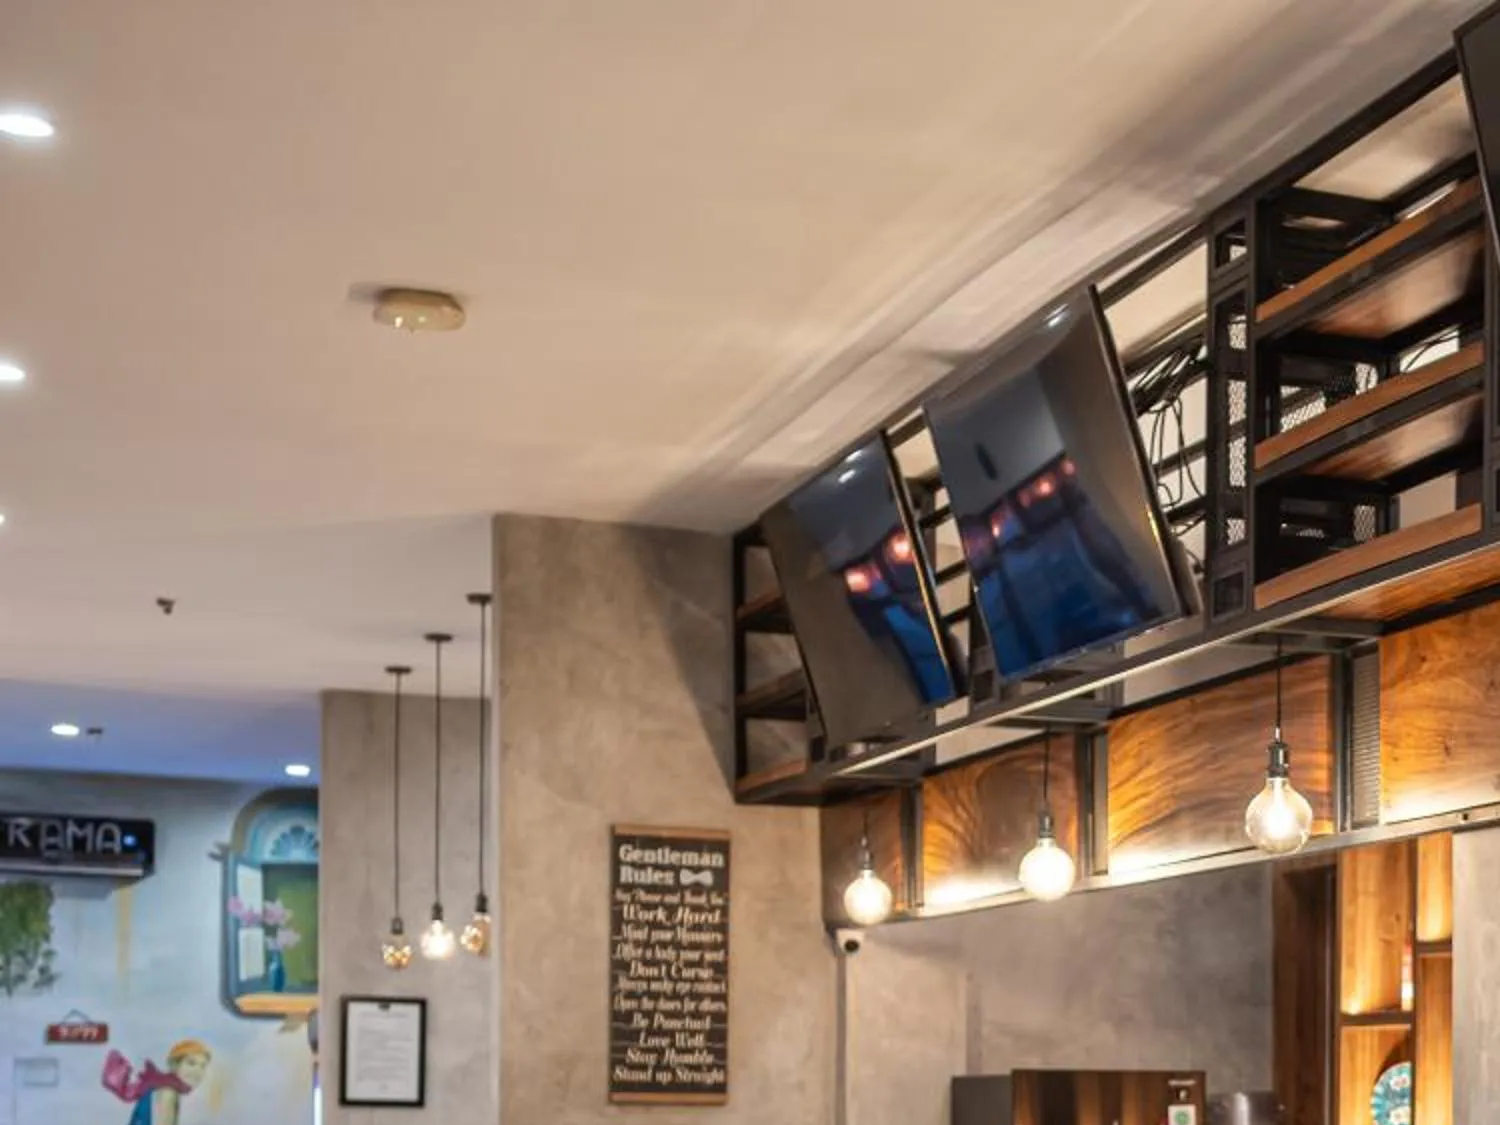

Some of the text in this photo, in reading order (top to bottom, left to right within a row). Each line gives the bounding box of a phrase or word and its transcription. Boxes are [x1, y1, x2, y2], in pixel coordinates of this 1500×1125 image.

[619, 843, 725, 868] Gentleman
[620, 865, 675, 886] Rules
[623, 903, 721, 927] Work Hard
[630, 958, 715, 979] Don't Curse
[632, 1011, 711, 1031] Be Punctual
[639, 1028, 706, 1049] Love Well
[625, 1047, 715, 1069] Stay Humble
[613, 1065, 725, 1086] Stand up Straight
